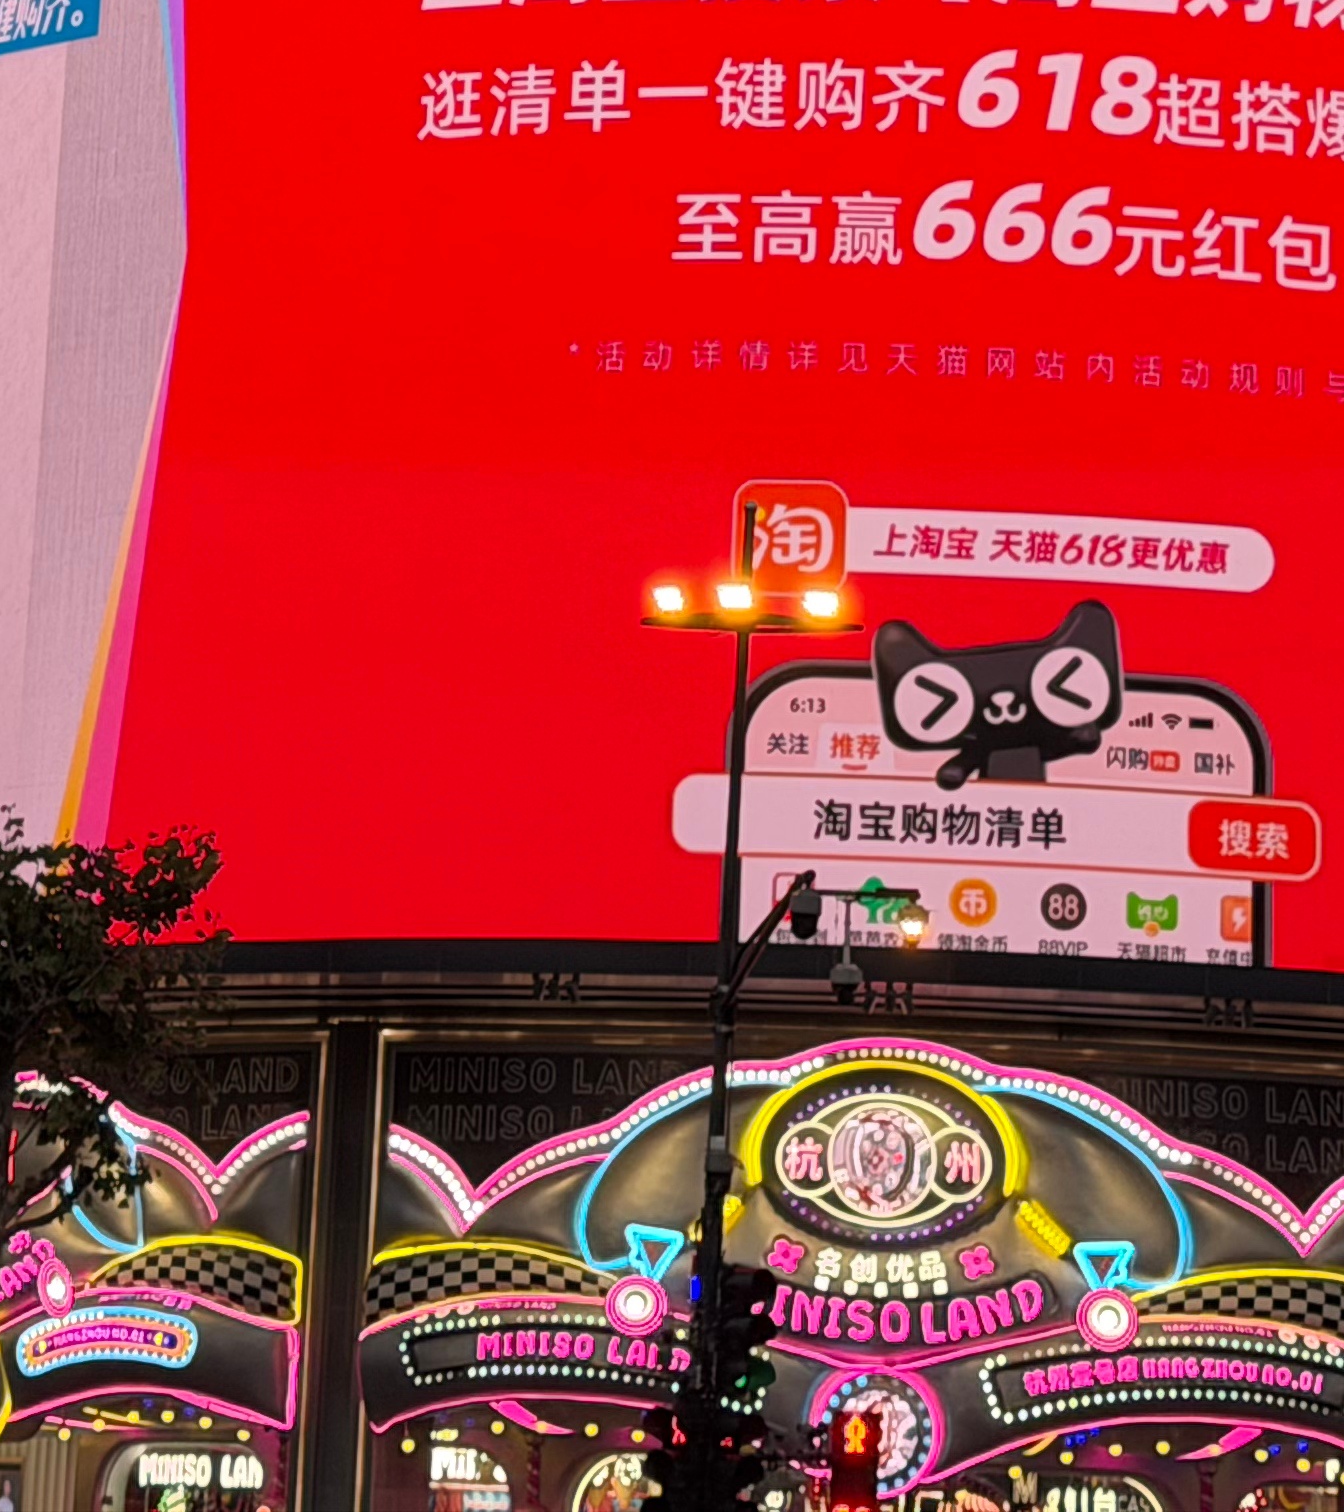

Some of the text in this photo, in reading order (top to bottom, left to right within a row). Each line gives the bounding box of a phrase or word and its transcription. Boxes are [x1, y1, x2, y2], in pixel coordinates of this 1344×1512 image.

[670, 180, 1339, 293] 至高赢666元红包
[872, 522, 1230, 575] 上淘宝 天猫618更优惠
[788, 696, 827, 715] 6:13
[766, 731, 810, 756] 关注
[829, 731, 881, 761] 推荐
[1106, 745, 1150, 771] 闪购
[812, 798, 1068, 850] 淘宝购物清单
[1217, 819, 1291, 862] 搜索
[1047, 892, 1080, 922] 88
[784, 1135, 981, 1185] 杭 州
[815, 1246, 947, 1284] 名创优品
[751, 1279, 1044, 1345] INISO LAND
[475, 1330, 595, 1361] MINISO
[138, 1452, 212, 1489] MINISO
